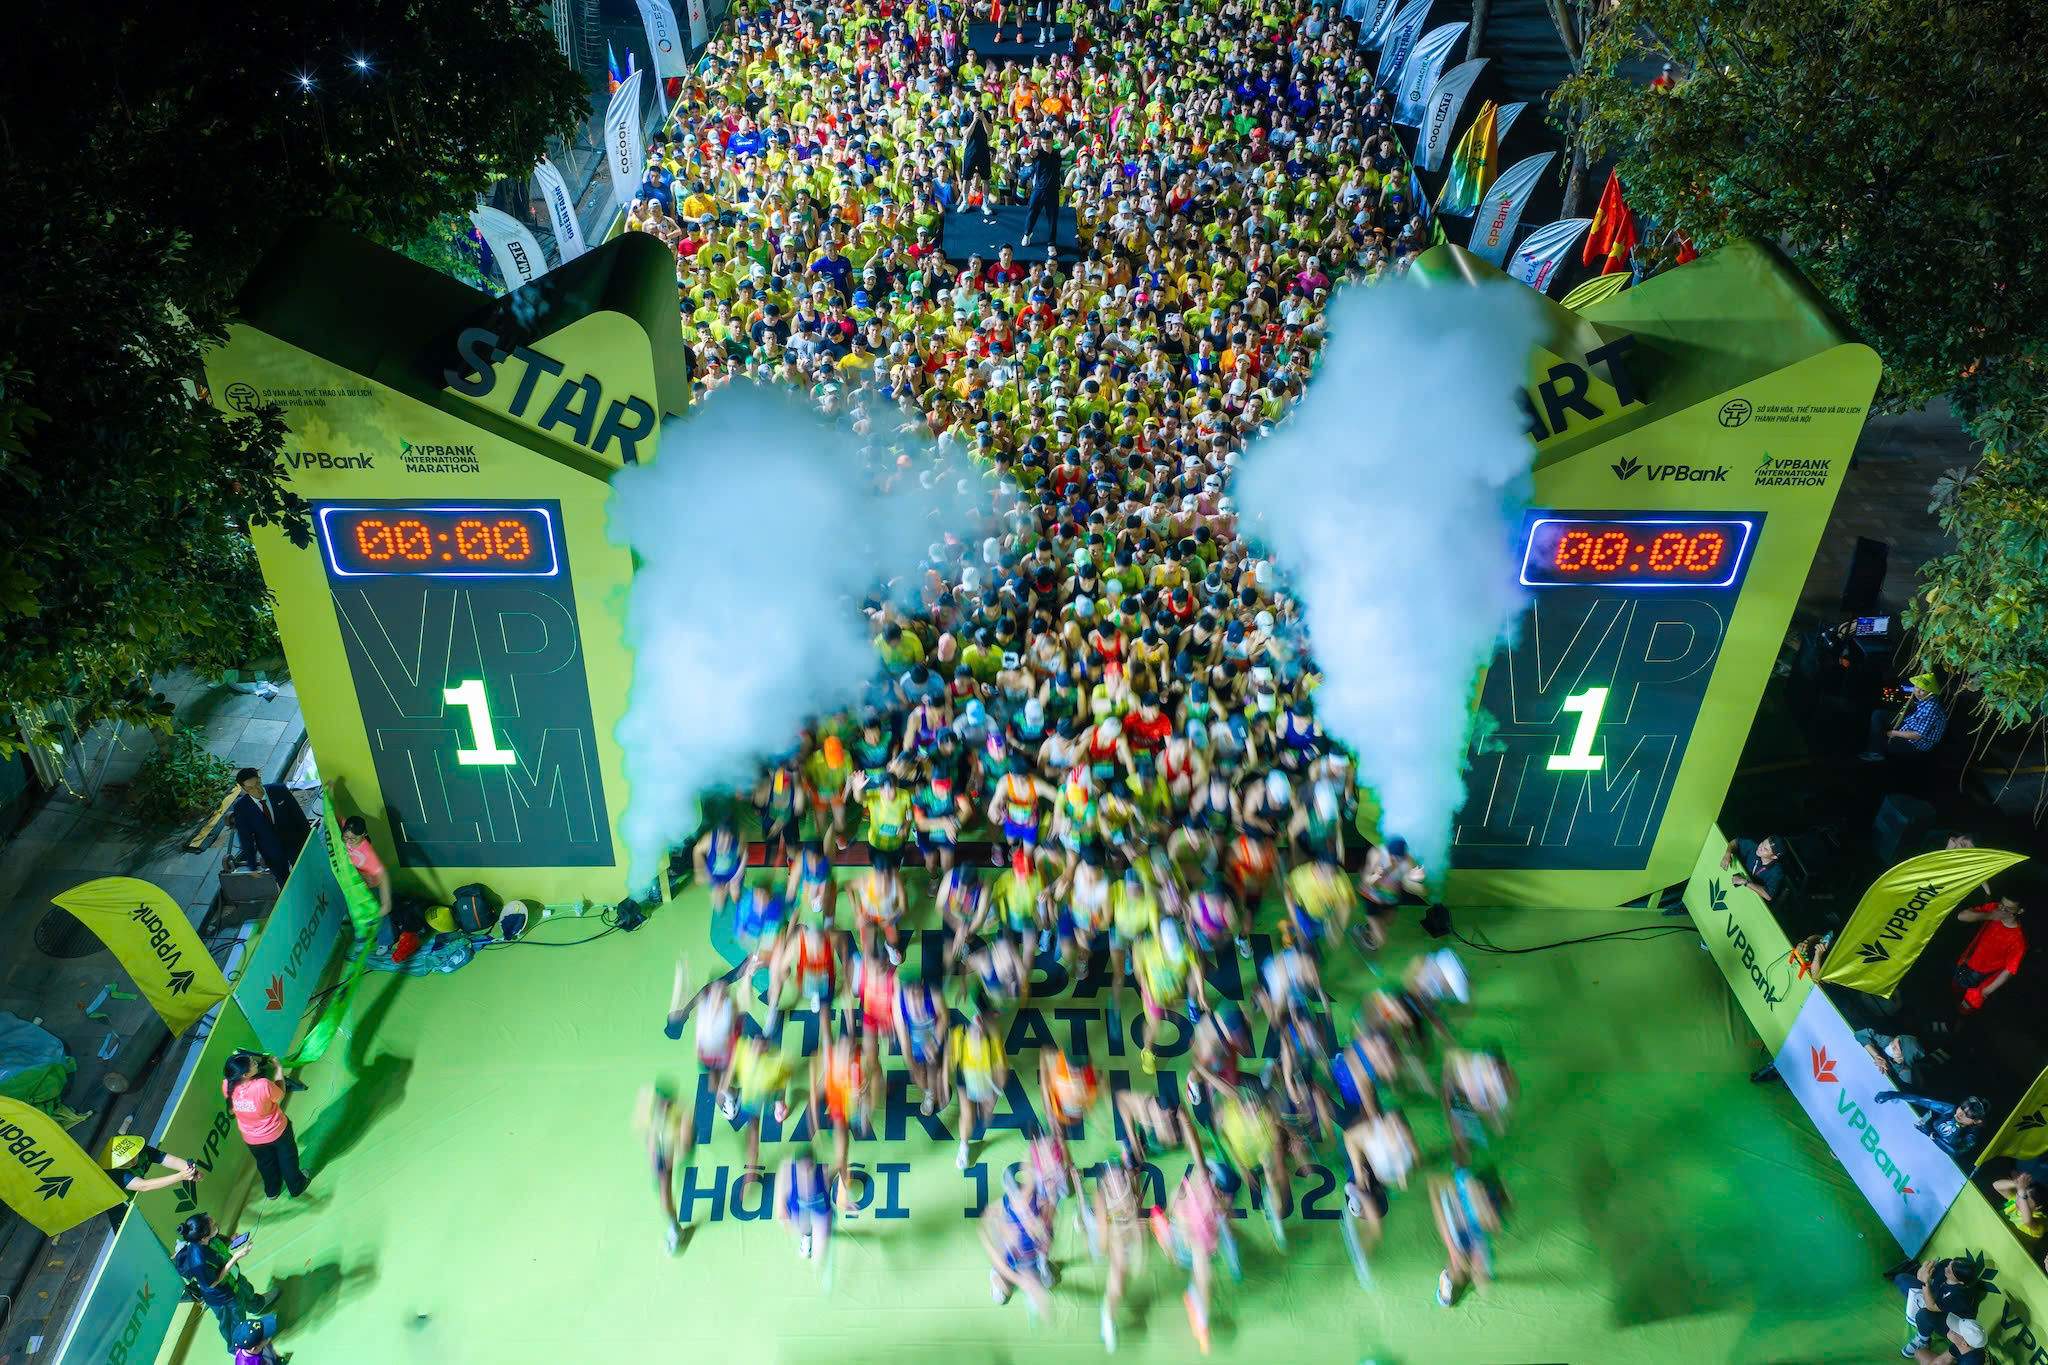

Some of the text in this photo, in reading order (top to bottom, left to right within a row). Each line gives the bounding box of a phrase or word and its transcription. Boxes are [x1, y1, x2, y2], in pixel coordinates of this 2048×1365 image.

[650, 3, 666, 38] OPES
[1487, 199, 1513, 248] GPBank
[442, 327, 664, 463] STAR
[284, 452, 374, 469] VPBank
[406, 464, 480, 473] MARATHON
[415, 445, 476, 456] VPBANK
[1646, 464, 1729, 483] VPBank
[1775, 459, 1832, 470] VPBANK
[1754, 477, 1826, 486] MARATHON
[355, 519, 532, 561] 00:00
[1554, 531, 1724, 572] 00:00
[443, 679, 517, 766] 1
[1546, 687, 1609, 771] 1
[132, 902, 182, 971] VPBank
[284, 891, 329, 980] VPBank
[1879, 883, 1944, 941] VPBank
[1726, 913, 1777, 1012] VPBank
[0, 1117, 56, 1176] VPBa
[196, 1110, 236, 1173] VPB
[1836, 1087, 1915, 1205] VPBank
[106, 1281, 156, 1365] Bank
